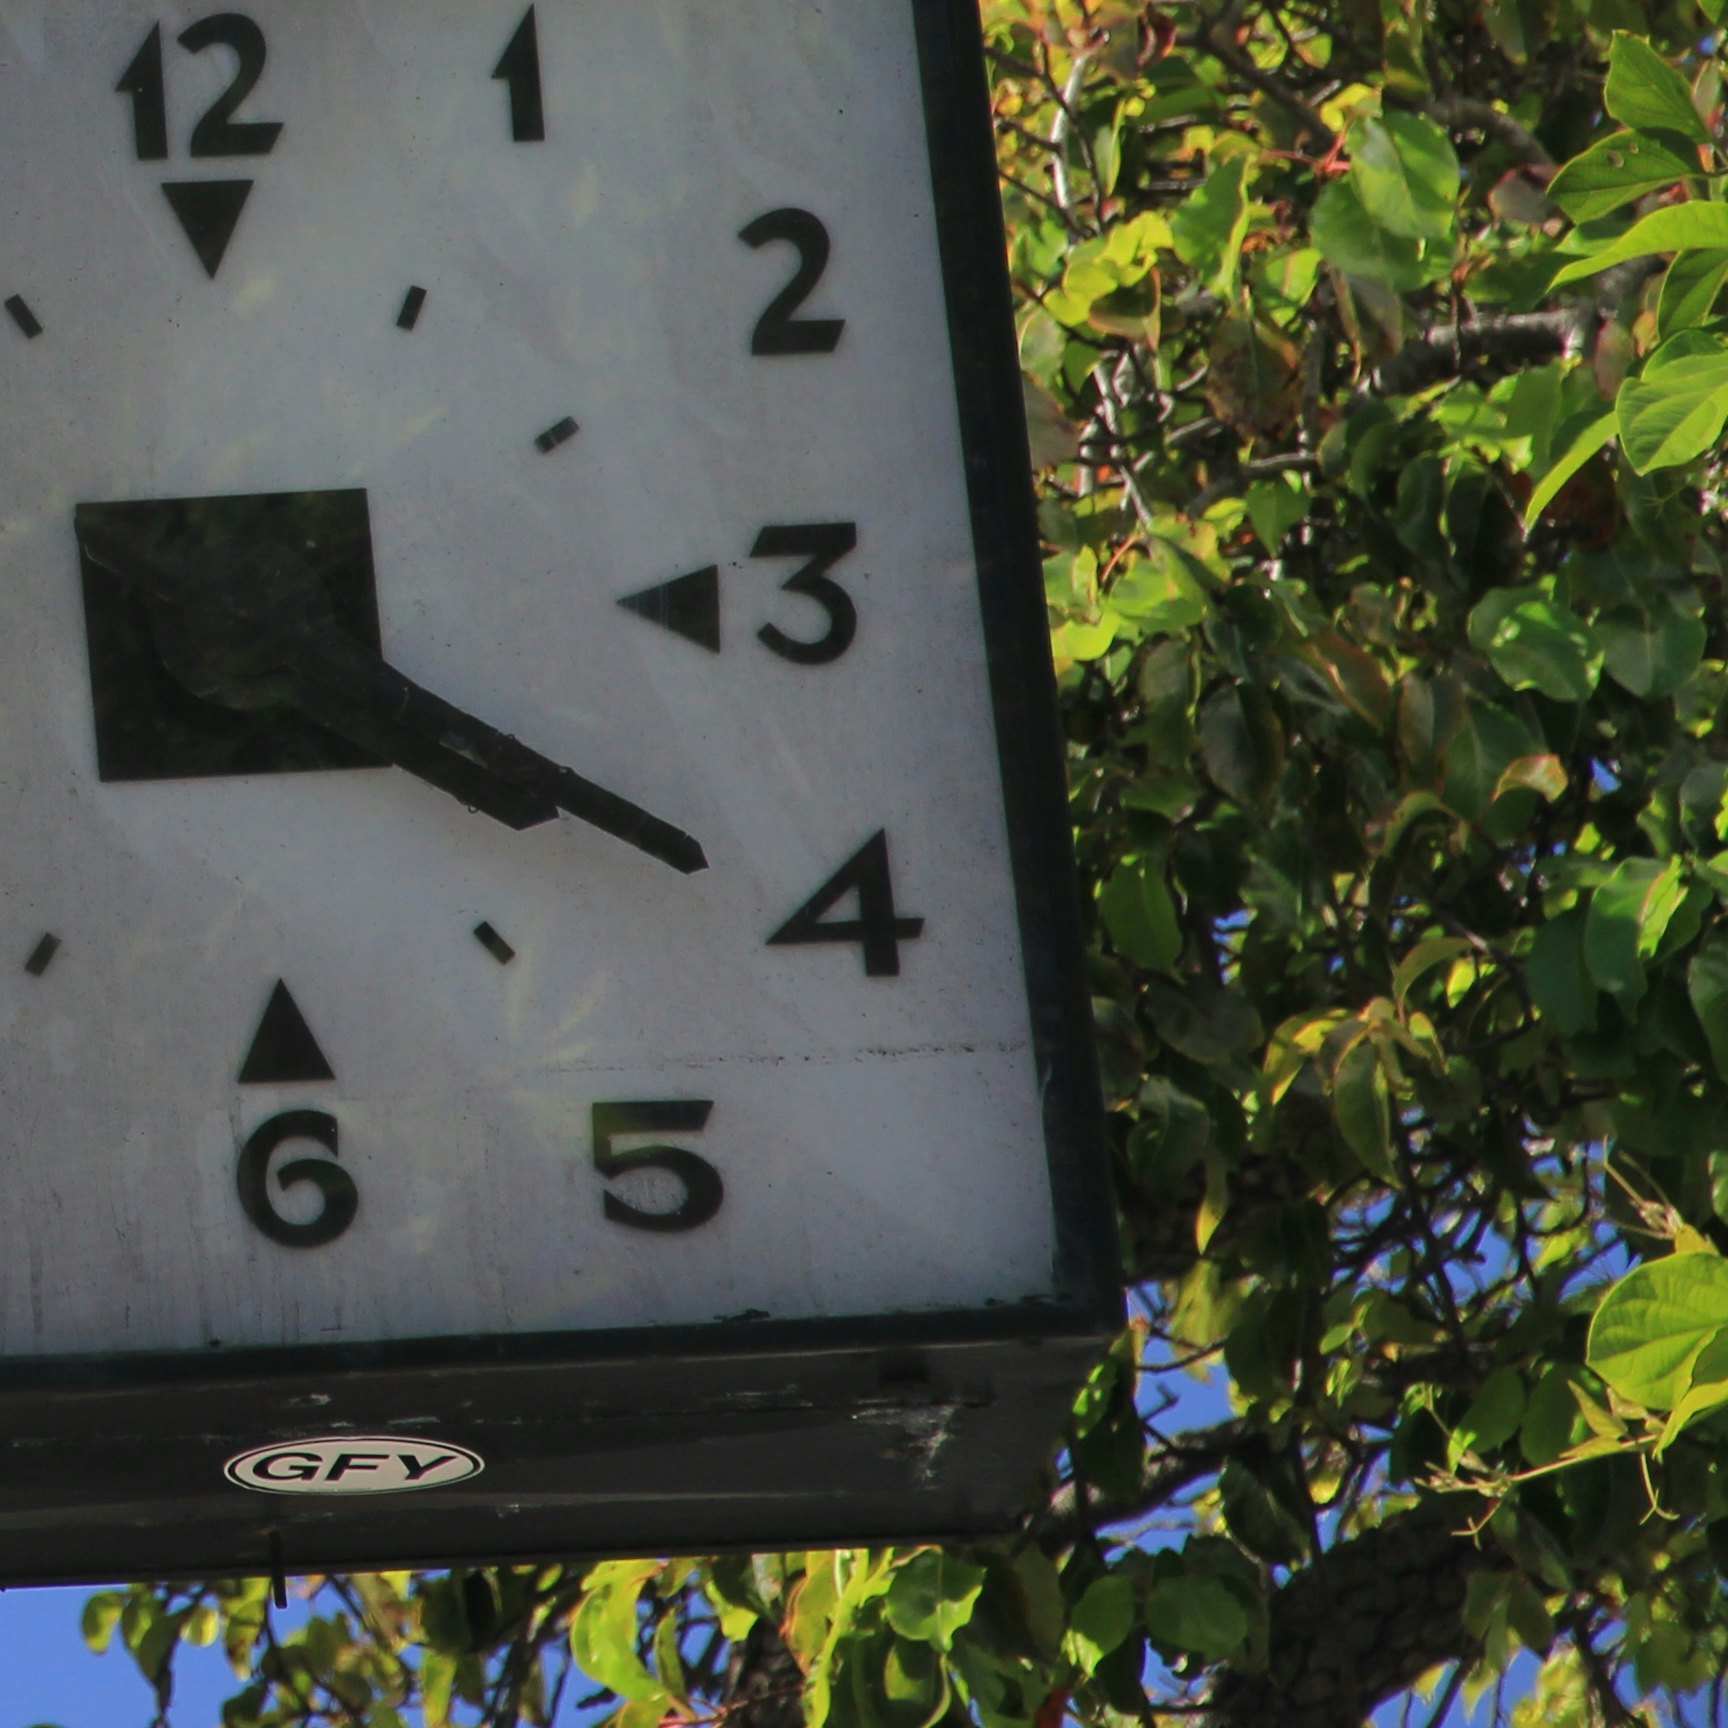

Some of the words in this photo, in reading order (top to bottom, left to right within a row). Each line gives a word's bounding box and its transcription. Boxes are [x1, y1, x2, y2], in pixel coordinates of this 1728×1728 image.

[114, 11, 284, 162] 12
[490, 3, 546, 143] 1
[737, 207, 846, 357] 2
[748, 521, 858, 666] 3
[765, 827, 926, 978] 4
[235, 1108, 360, 1251] 6
[591, 1099, 725, 1237] 5
[252, 1452, 457, 1481] GFY
